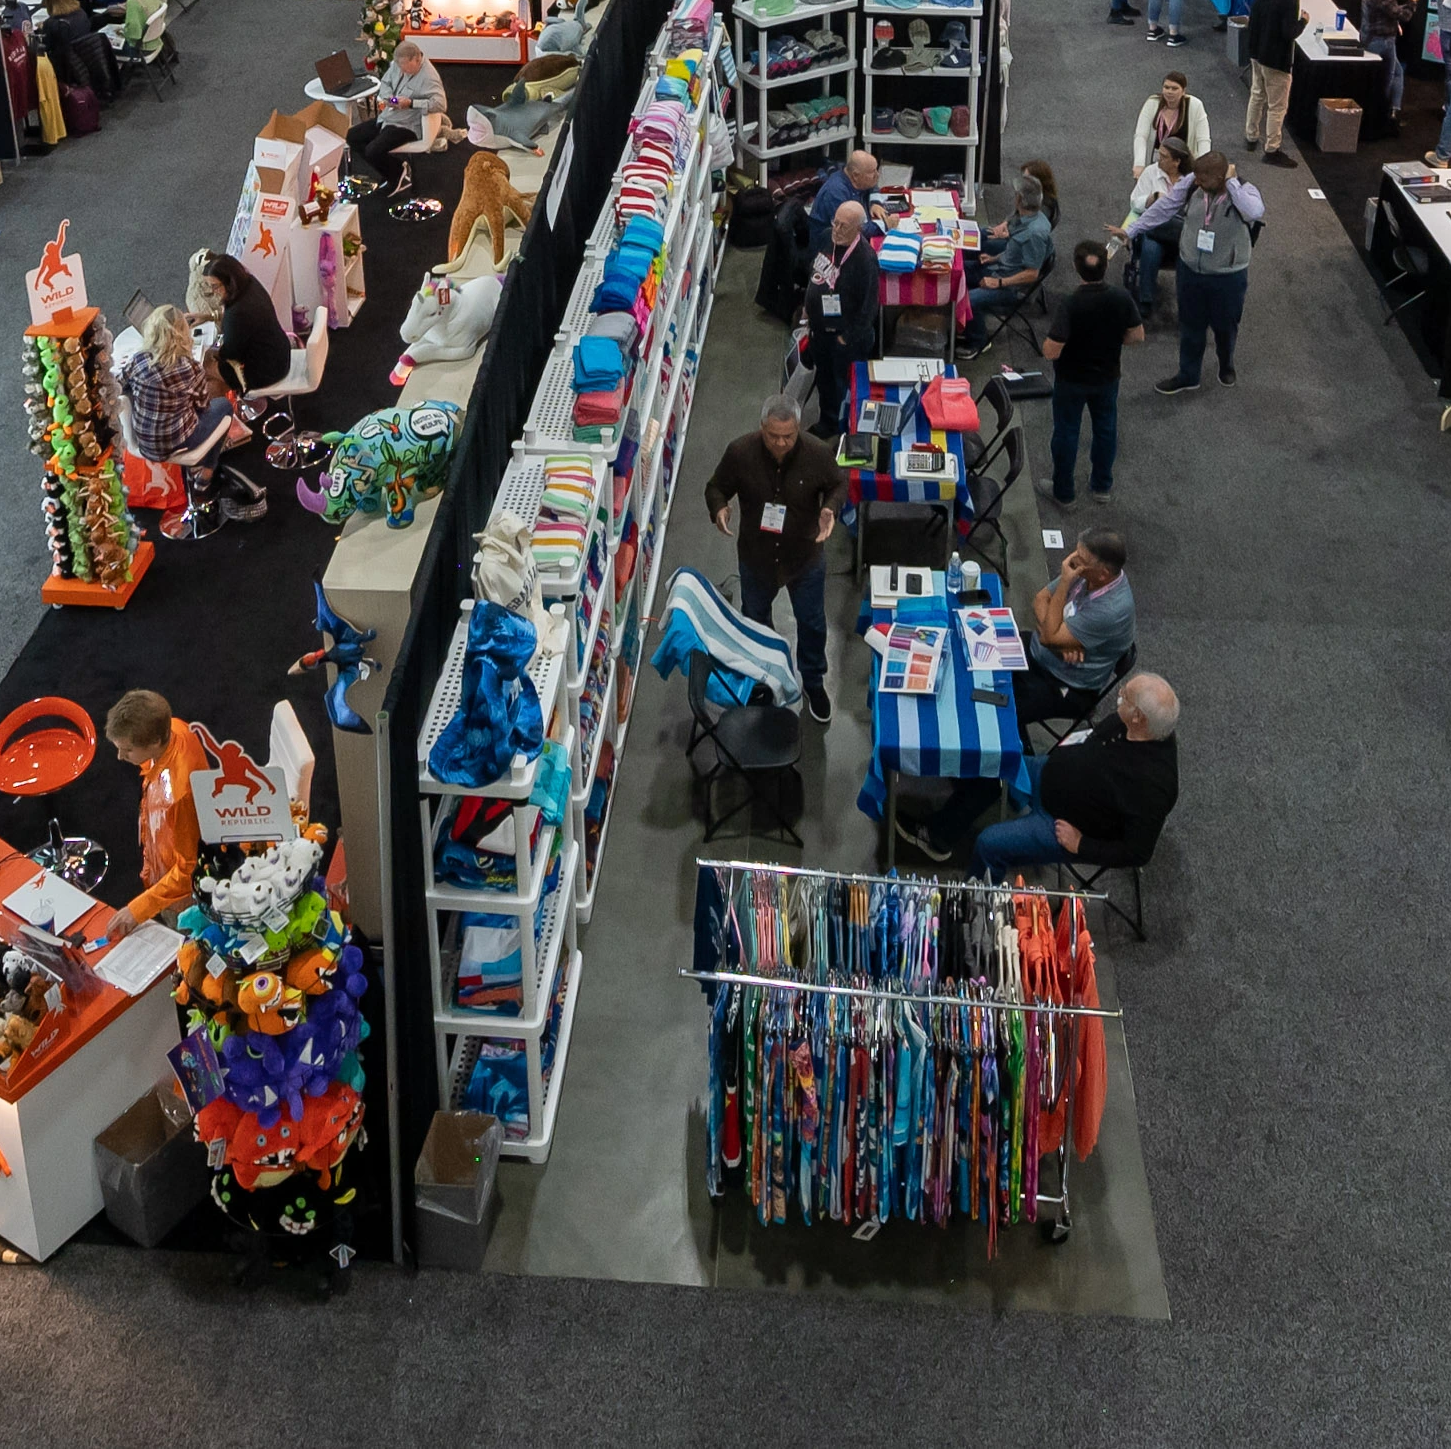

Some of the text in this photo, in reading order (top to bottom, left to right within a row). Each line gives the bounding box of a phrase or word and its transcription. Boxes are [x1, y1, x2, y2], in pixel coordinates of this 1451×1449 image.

[40, 286, 75, 305] WILD
[214, 806, 271, 819] WILD
[220, 818, 275, 827] REPUBLIC
[30, 1027, 60, 1059] WILD
